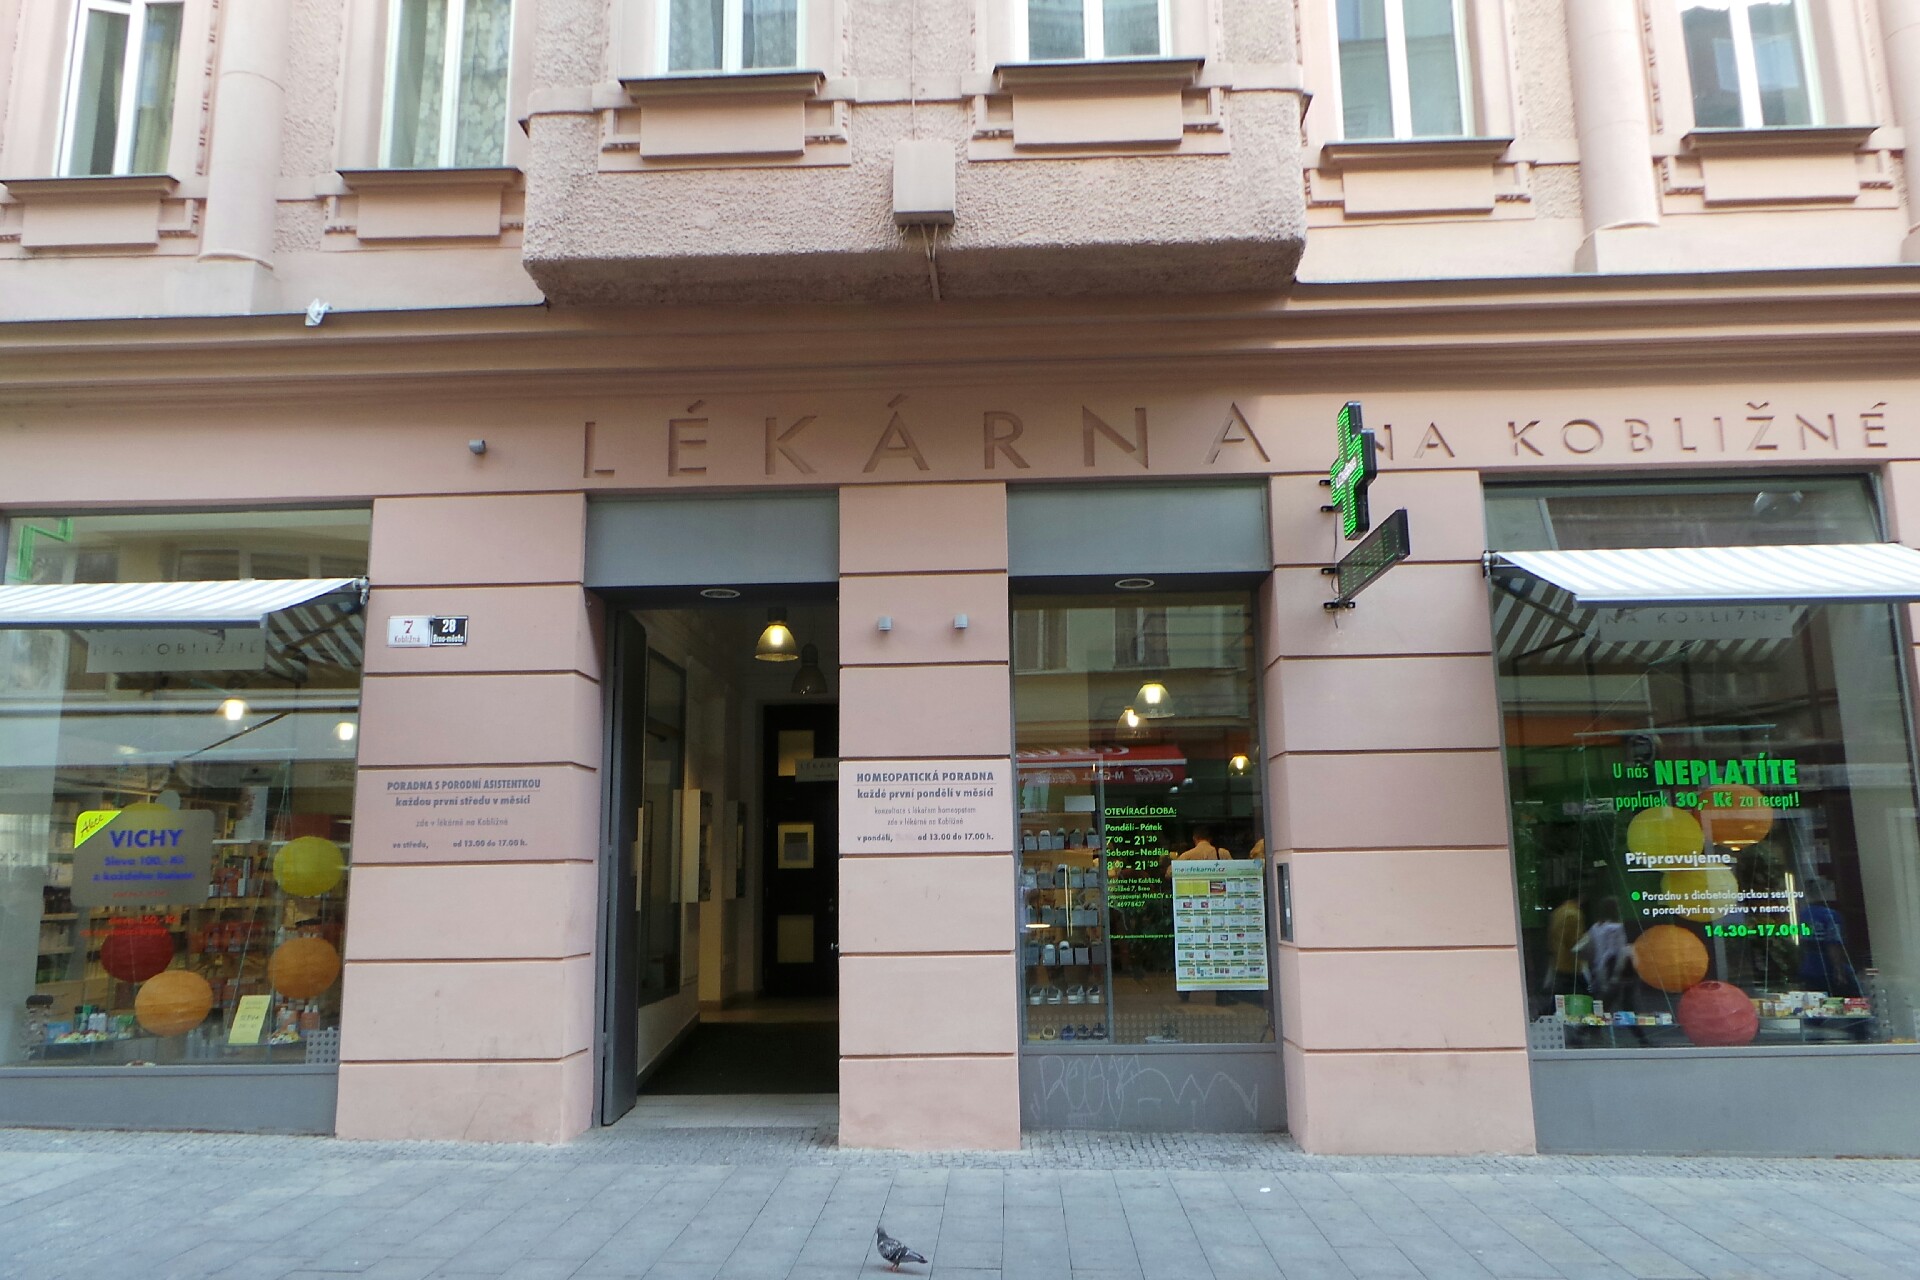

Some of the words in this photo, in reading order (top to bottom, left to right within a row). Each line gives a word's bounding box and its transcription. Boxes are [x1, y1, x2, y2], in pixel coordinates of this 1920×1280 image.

[583, 395, 1271, 478] LÉKÁRNA
[1508, 402, 1889, 458] KOBLIŽNÉ
[404, 619, 414, 634] 7
[441, 619, 457, 633] 28
[1613, 763, 1622, 778] U
[1627, 763, 1648, 778] nás
[1654, 752, 1797, 785] NEPLATÍTE
[856, 770, 939, 782] HOMEOPATICKÁ
[942, 771, 994, 781] PORADNA
[387, 781, 433, 791] PORADNA
[435, 780, 440, 790] S
[441, 778, 481, 790] PORODNÍ
[483, 778, 541, 789] ASISTENTKOU
[857, 787, 887, 799] každé
[889, 788, 915, 800] první
[916, 787, 953, 800] pondělí
[963, 787, 994, 797] měsíci
[395, 796, 431, 807] každou
[433, 796, 458, 808] první
[460, 795, 491, 806] středu
[492, 797, 499, 805] v
[500, 795, 530, 805] měsíci
[1616, 791, 1669, 811] poplatek
[1676, 791, 1709, 810] 30,-
[1713, 791, 1733, 808] Kč
[1740, 795, 1753, 807] za
[1757, 791, 1800, 811] recept!
[1104, 805, 1148, 816] OTEVÍRACÍ
[1149, 807, 1177, 815] DOBA:
[109, 829, 184, 848] VICHY
[403, 840, 429, 849] středu,
[498, 839, 519, 847] 17.00
[862, 833, 893, 843] pondělí,
[917, 833, 927, 841] od
[929, 833, 951, 841] 13.00
[952, 833, 962, 841] do
[986, 832, 994, 840] h.
[1625, 851, 1731, 868] Připravujeme
[1642, 891, 1681, 901] Poradnu
[1684, 892, 1688, 900] s
[1691, 890, 1768, 903] diabetologickou
[1643, 908, 1650, 916] a
[1652, 904, 1701, 917] poradkyní
[1702, 906, 1715, 914] na
[1718, 904, 1749, 916] výživu
[1802, 923, 1811, 937] h
